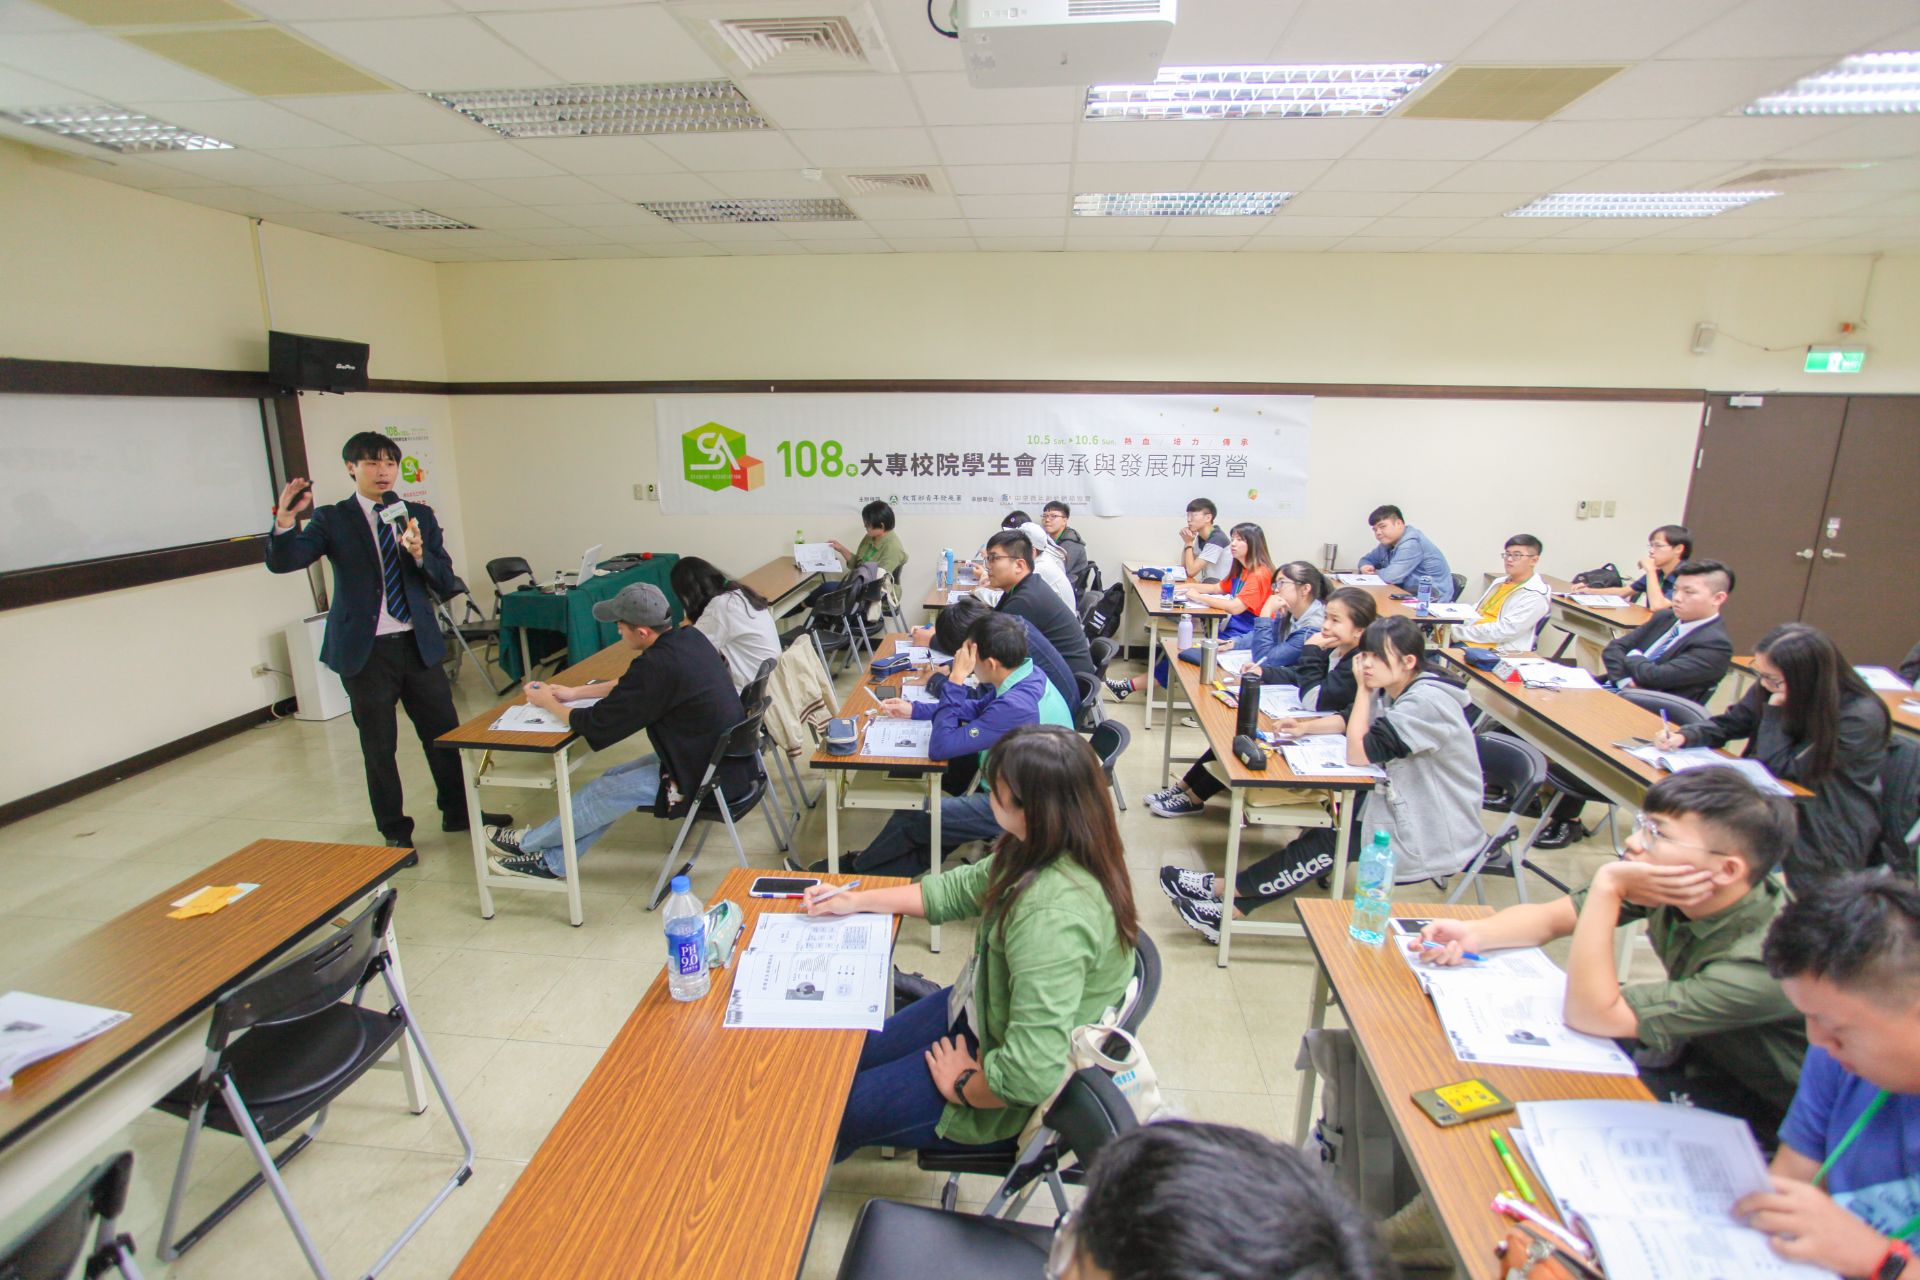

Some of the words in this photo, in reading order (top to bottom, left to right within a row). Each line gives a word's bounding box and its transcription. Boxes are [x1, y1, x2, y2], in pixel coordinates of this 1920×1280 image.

[1027, 434, 1051, 445] 10.5
[1075, 434, 1099, 445] 10.6
[1258, 853, 1334, 895] adidas
[681, 944, 697, 957] PH
[681, 954, 698, 968] 9.0
